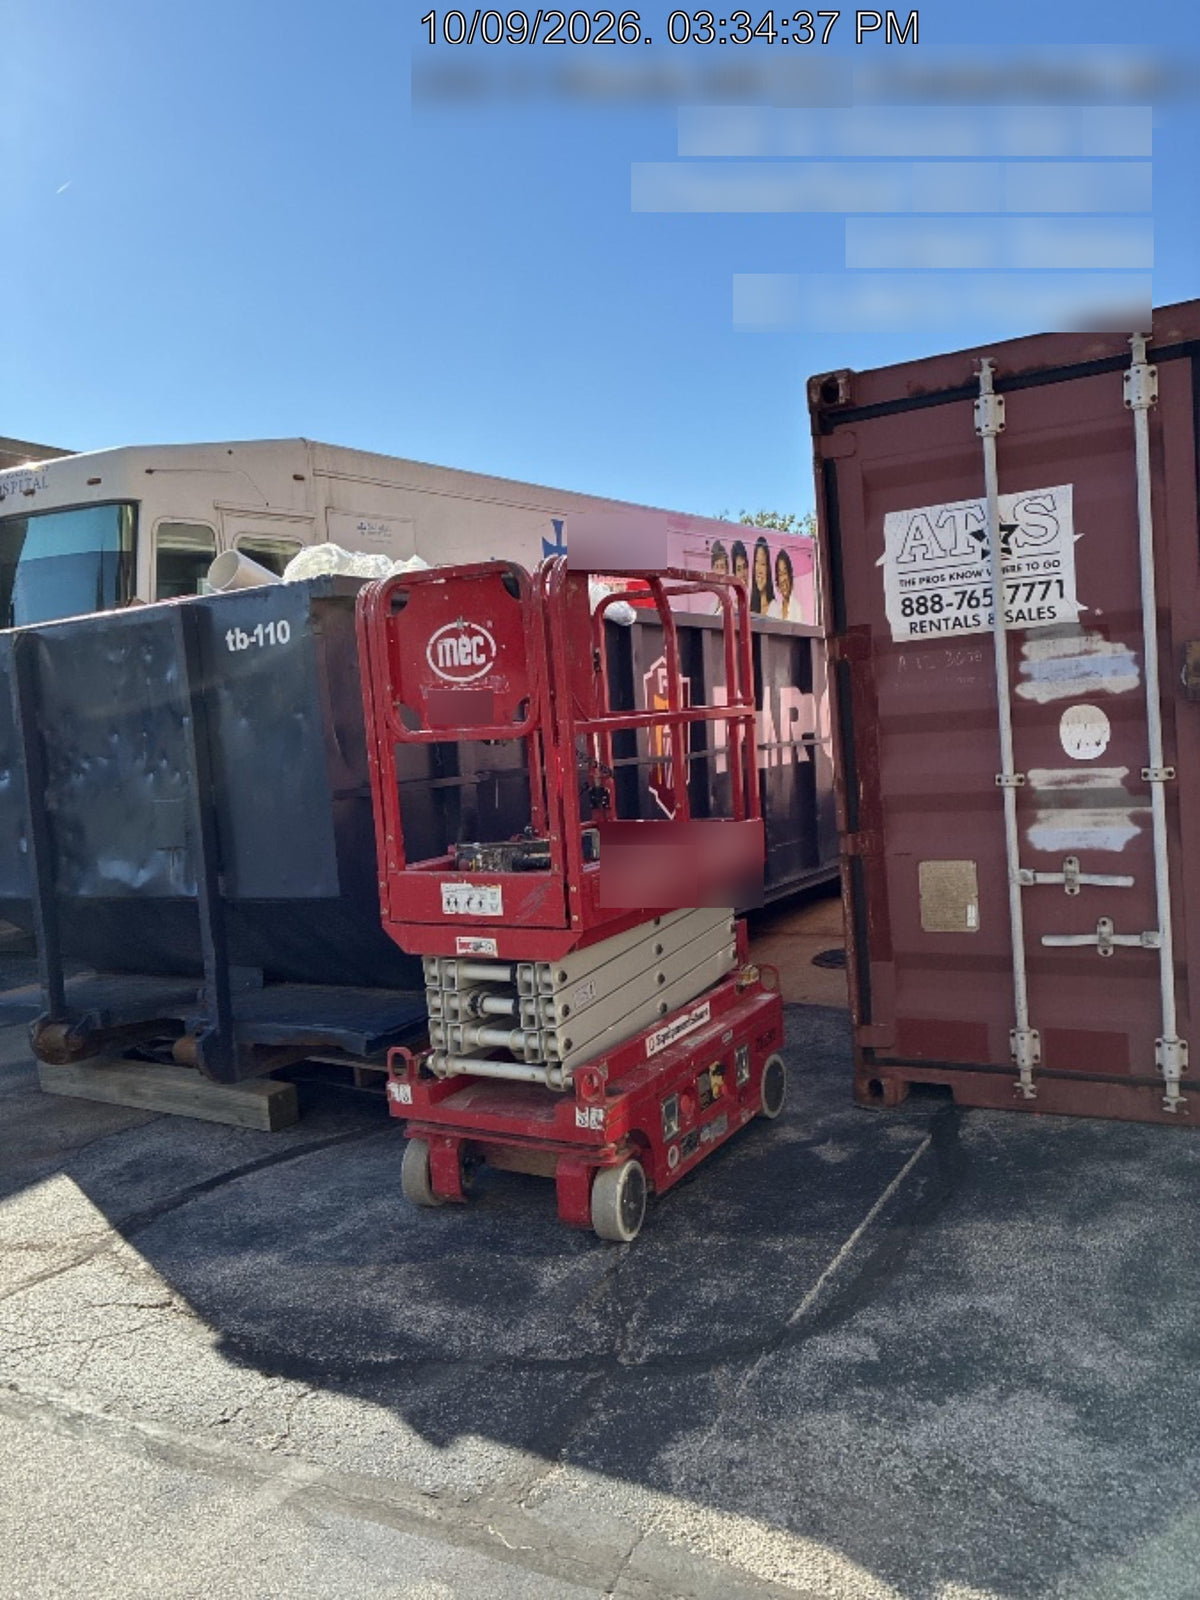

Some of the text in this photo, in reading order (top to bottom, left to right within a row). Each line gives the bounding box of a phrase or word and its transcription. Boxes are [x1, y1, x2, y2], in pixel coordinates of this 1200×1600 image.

[899, 577, 916, 589] THE
[919, 573, 946, 585] PROS
[948, 567, 983, 581] KNOW
[1025, 561, 1040, 571] TO
[1043, 559, 1061, 570] GO
[909, 613, 982, 635] RENTALS
[1004, 605, 1057, 624] SALES
[224, 619, 291, 653] tb-110
